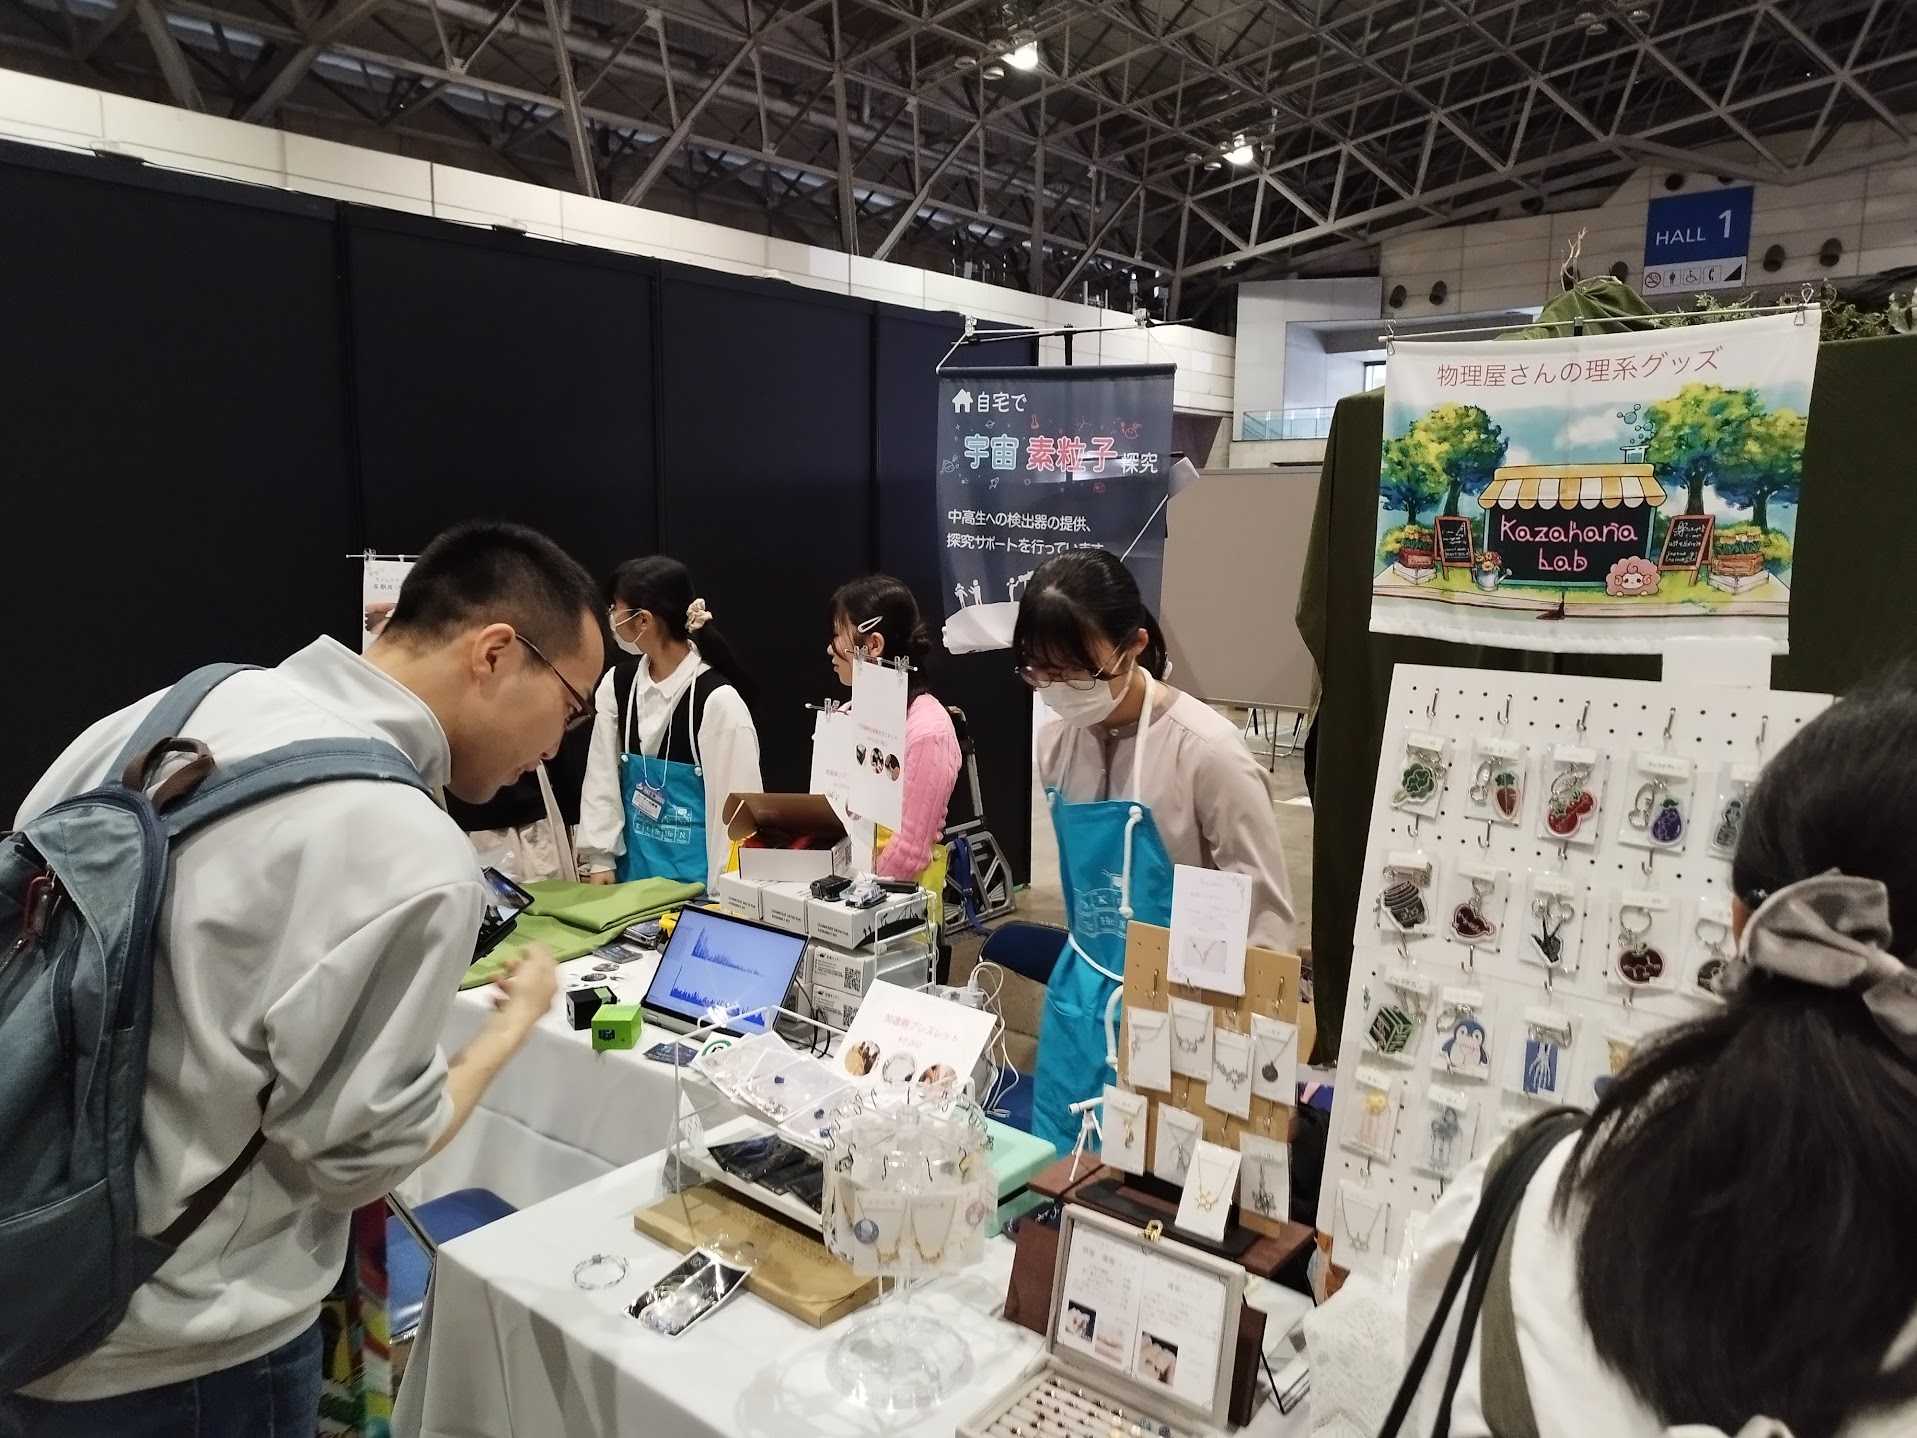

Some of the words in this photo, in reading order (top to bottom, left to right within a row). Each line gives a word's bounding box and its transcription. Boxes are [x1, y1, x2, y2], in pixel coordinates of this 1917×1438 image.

[1655, 226, 1706, 246] HALL
[1718, 209, 1732, 239] 1
[1437, 345, 1724, 387] 物理屋さんの理系グッズ
[977, 391, 1027, 412] 自宅で
[964, 433, 1019, 471] 宇宙
[1026, 435, 1119, 473] 素粒子
[1120, 451, 1159, 474] 探究
[947, 508, 1091, 533] 中高生への検出器の提供、
[1499, 514, 1639, 543] Kazahana
[1538, 547, 1588, 572] Lab
